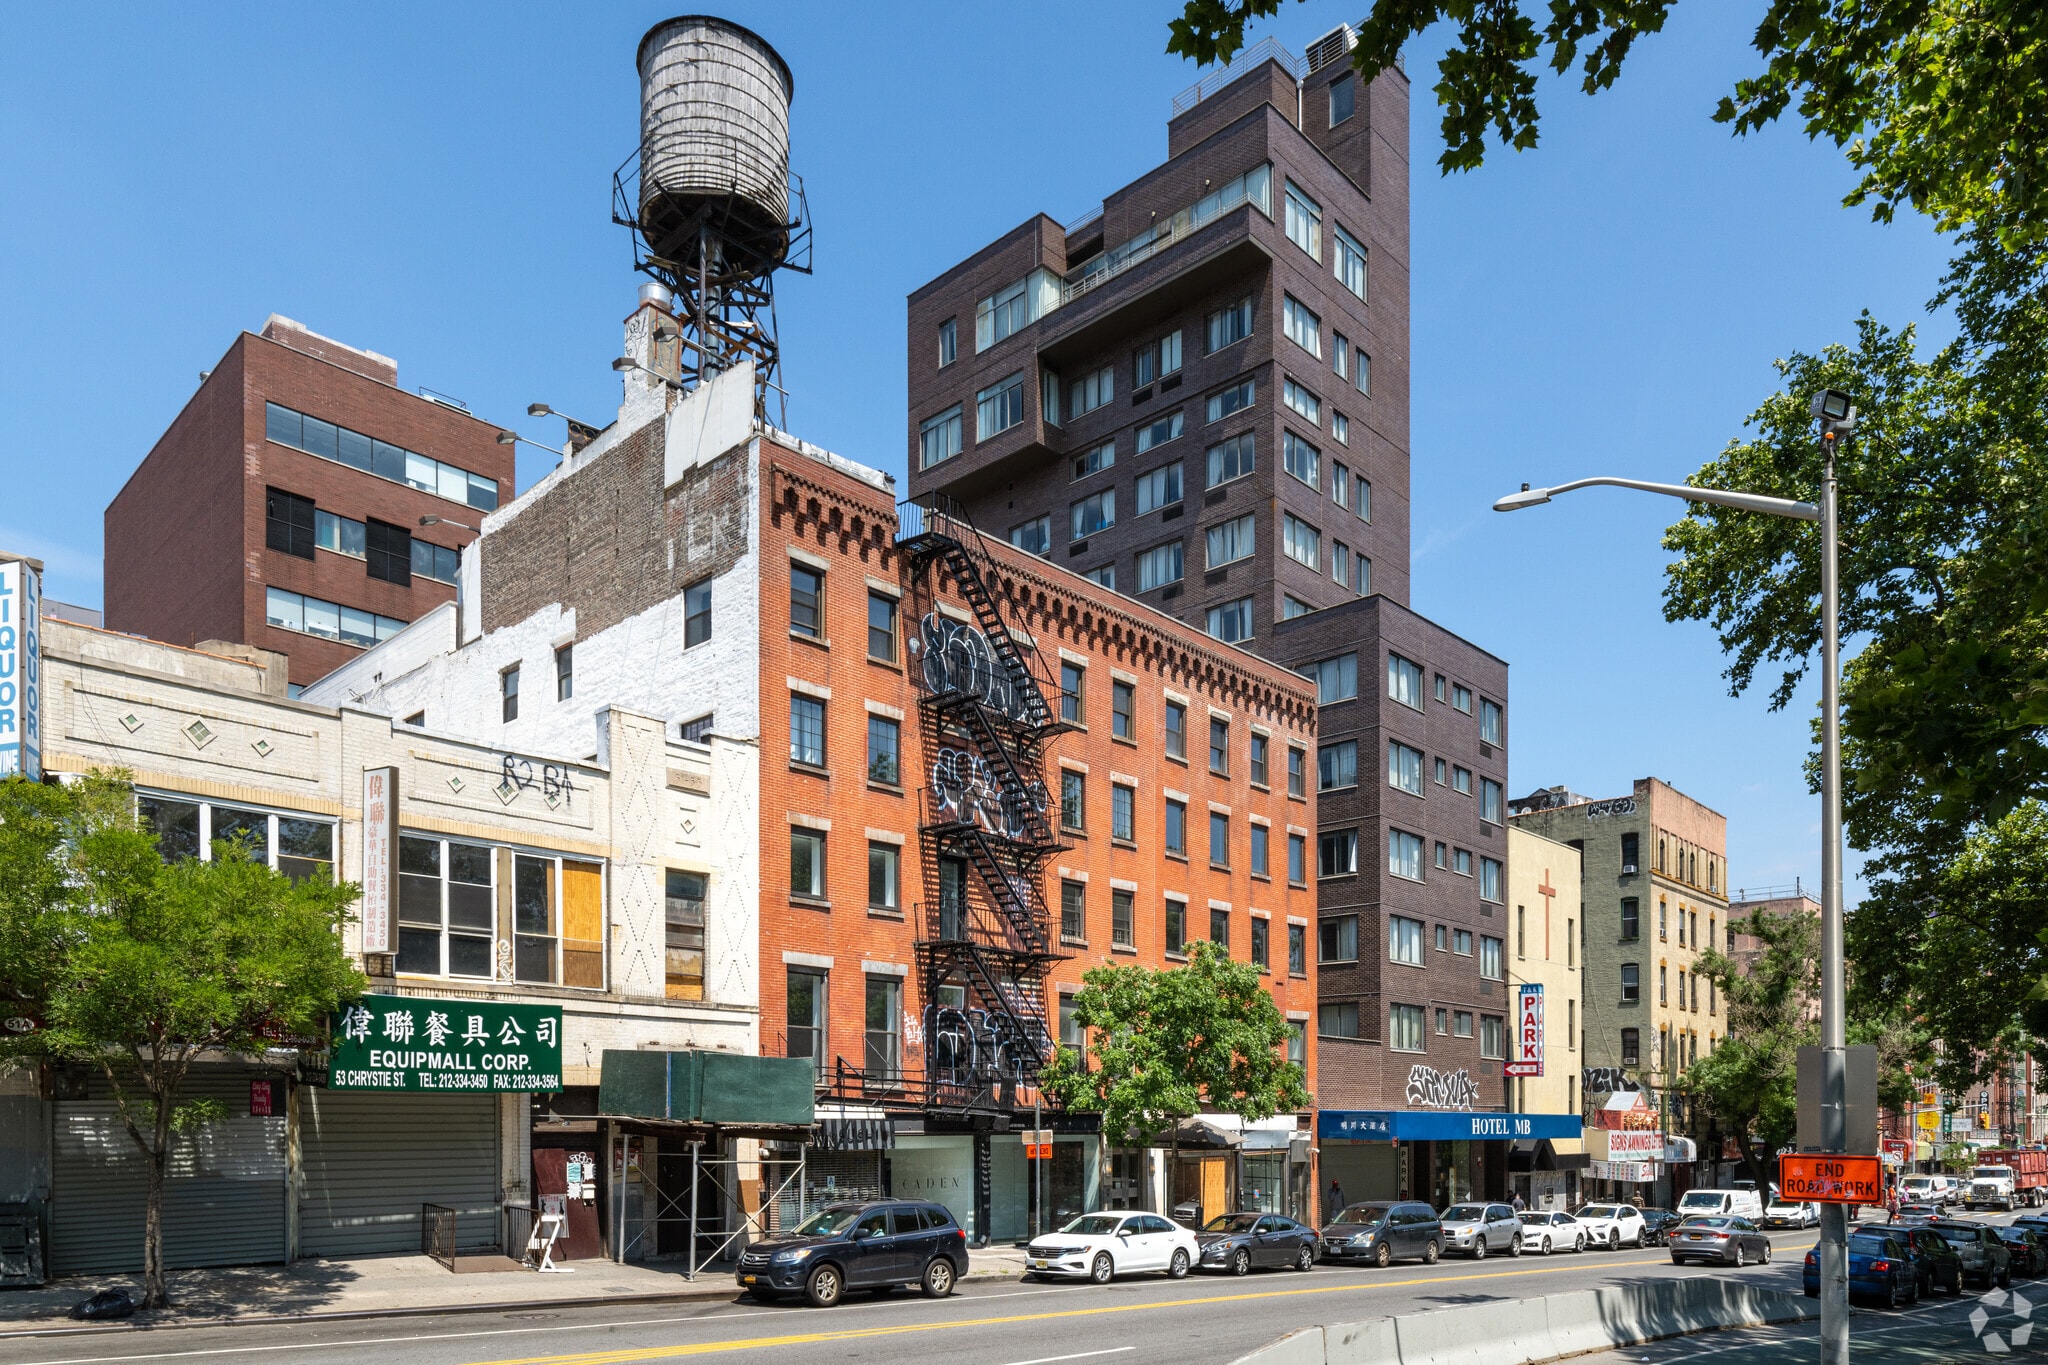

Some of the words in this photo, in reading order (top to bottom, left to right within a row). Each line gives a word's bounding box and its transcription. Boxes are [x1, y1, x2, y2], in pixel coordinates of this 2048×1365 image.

[27, 574, 38, 740] LIQUOR
[341, 1006, 557, 1049] 偉聯餐具公司
[1523, 996, 1537, 1058] PARK
[370, 1050, 476, 1070] EQUIPMALL
[481, 1053, 532, 1071] CORP.
[335, 1070, 346, 1086] 53
[348, 1071, 391, 1087] CHRYSTIE
[393, 1072, 406, 1087] ST.
[419, 1072, 437, 1088] TEL:
[438, 1073, 488, 1089] 212-334-3450
[493, 1074, 511, 1089] FAX:
[512, 1073, 559, 1089] 212-334-3564
[1471, 1118, 1510, 1135] HOTEL
[1514, 1119, 1531, 1135] MB
[1815, 1163, 1845, 1177] END
[902, 1176, 960, 1190] CADEN
[1787, 1178, 1825, 1193] ROAD
[1833, 1181, 1875, 1196] WORK
